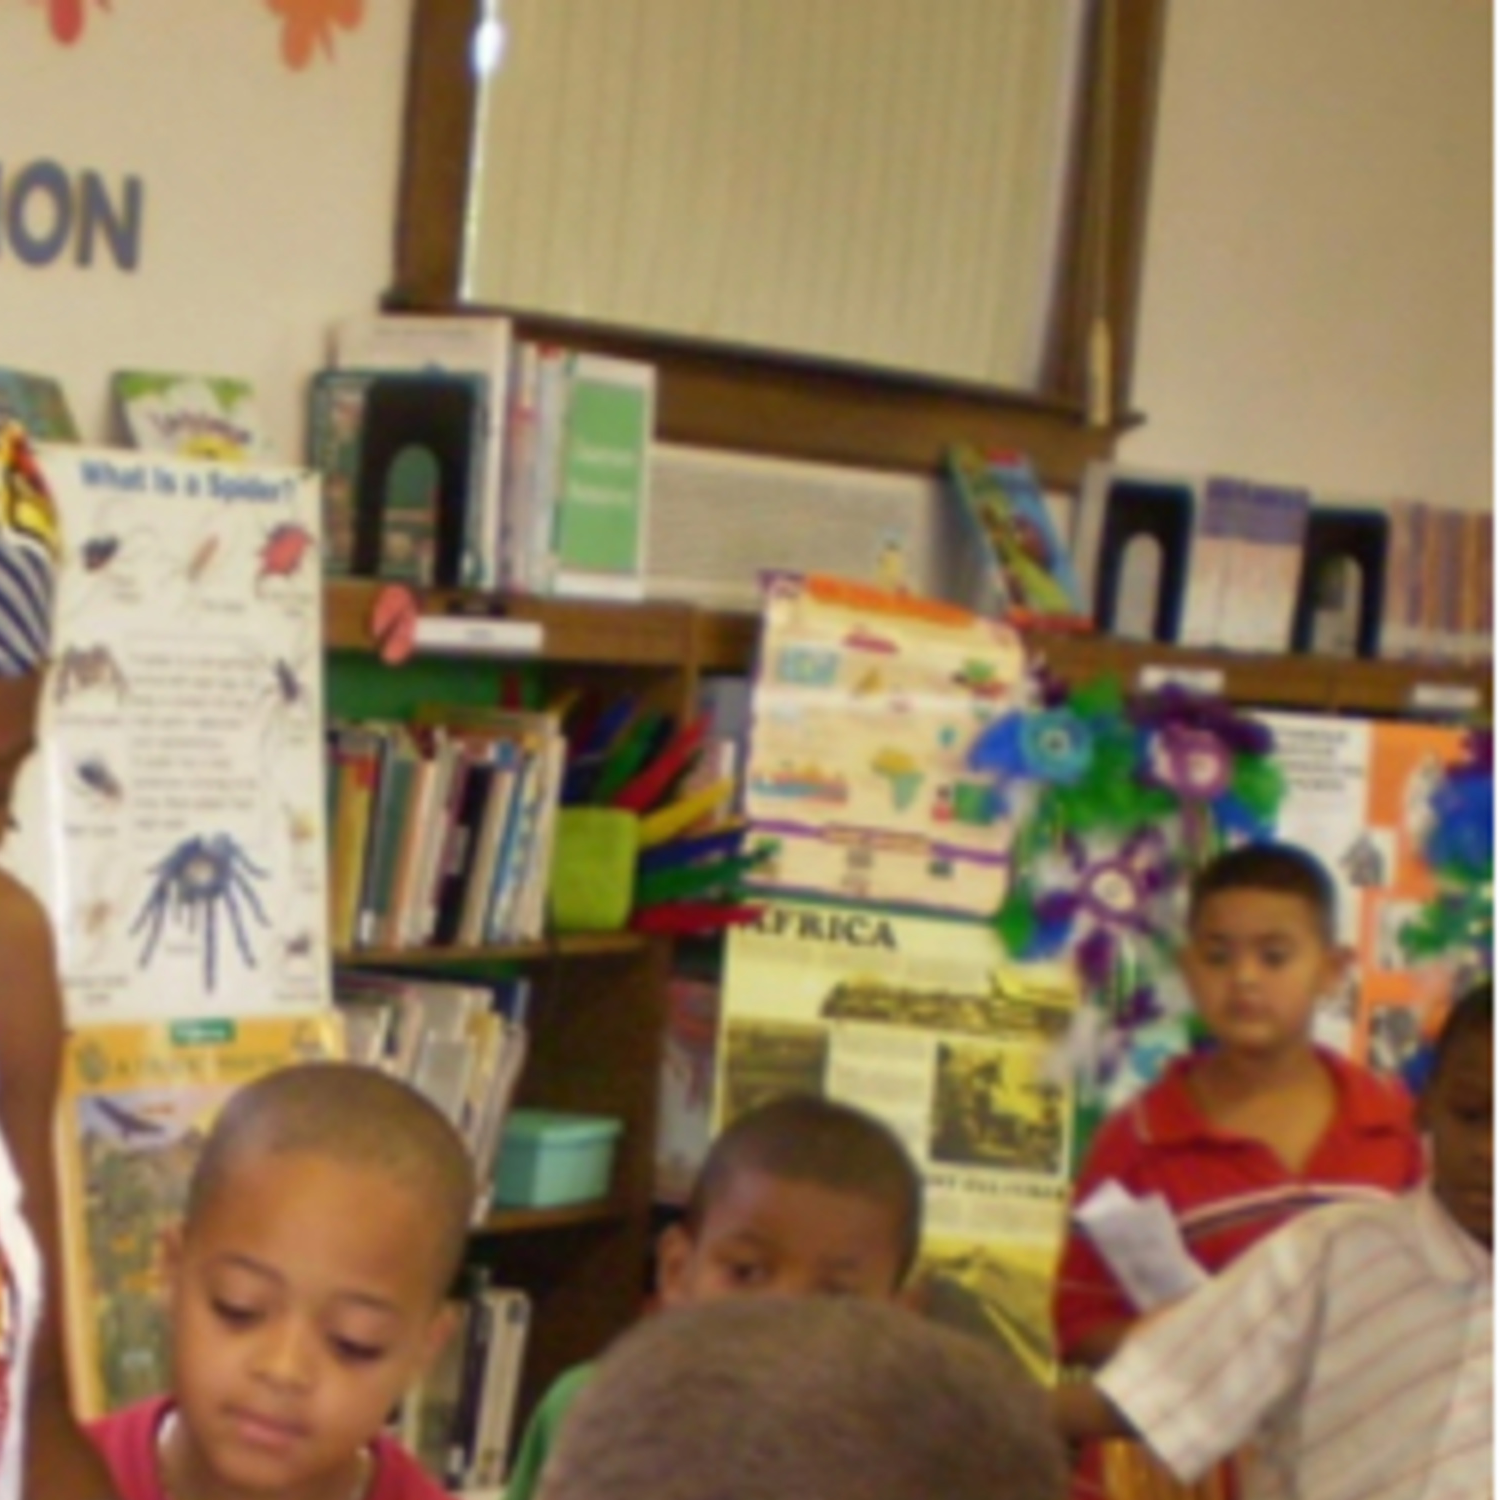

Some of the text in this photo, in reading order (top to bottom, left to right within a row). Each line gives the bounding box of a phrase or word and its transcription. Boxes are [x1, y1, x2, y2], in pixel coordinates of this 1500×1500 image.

[80, 459, 147, 491] What
[184, 473, 199, 497] a
[206, 468, 297, 504] Spider?
